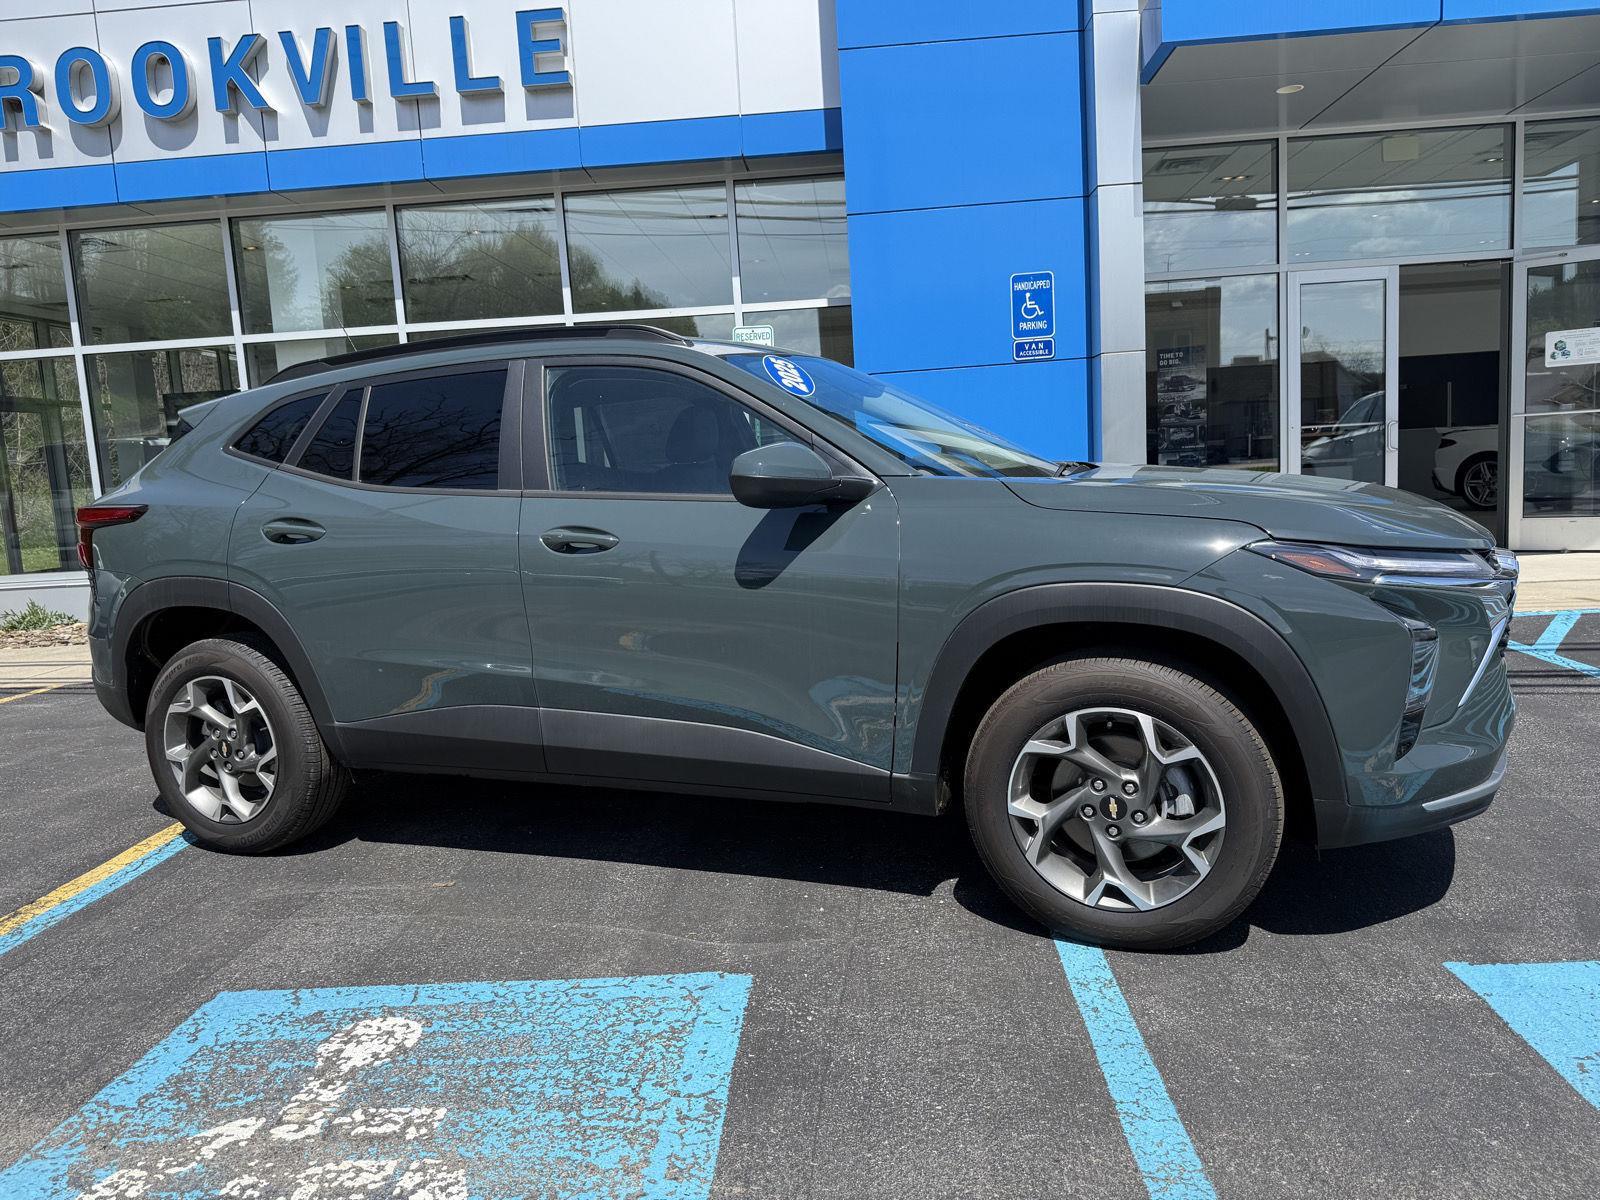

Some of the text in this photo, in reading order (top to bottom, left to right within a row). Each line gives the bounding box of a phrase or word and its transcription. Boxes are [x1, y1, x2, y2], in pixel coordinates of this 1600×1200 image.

[1014, 280, 1051, 291] HANDICAPPED
[1019, 320, 1048, 331] PARKING
[735, 331, 771, 341] RESERVED
[1024, 342, 1044, 350] VAN
[768, 357, 809, 393] 2025
